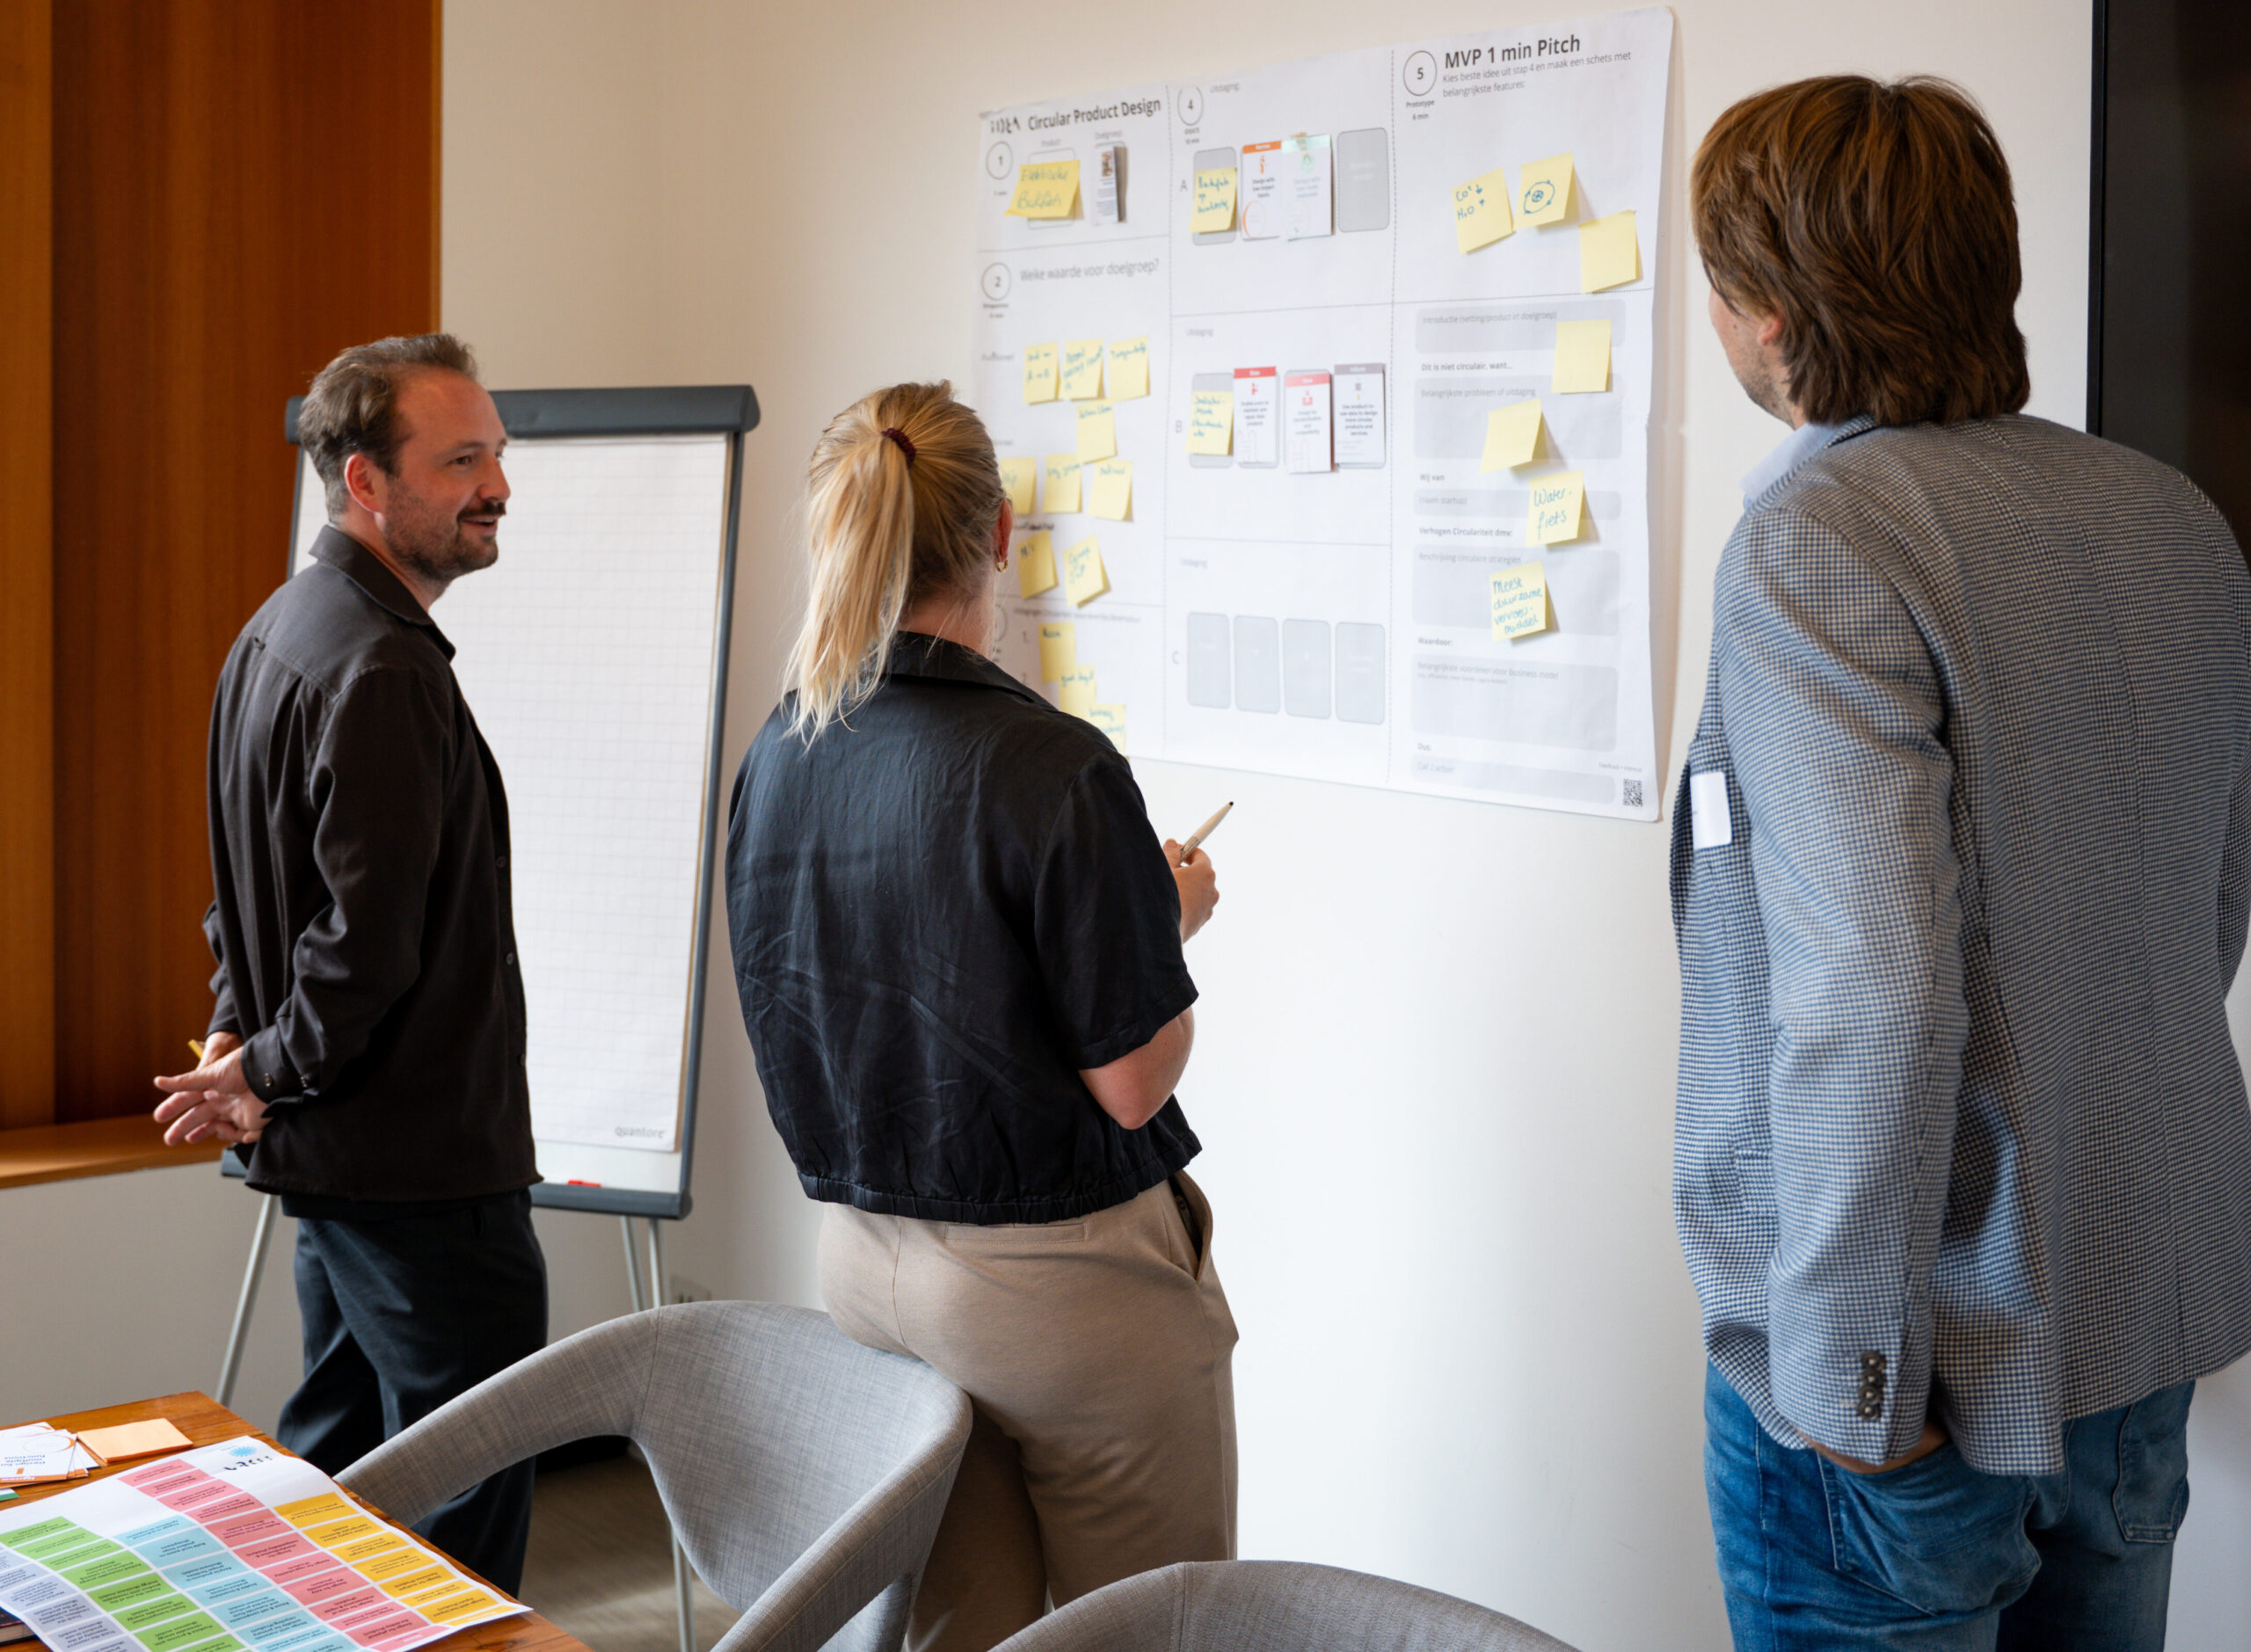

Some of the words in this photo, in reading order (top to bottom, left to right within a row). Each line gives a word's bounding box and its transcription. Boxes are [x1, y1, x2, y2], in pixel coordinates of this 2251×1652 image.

[1445, 48, 1482, 69] MVP
[1487, 47, 1496, 64] 1
[1501, 42, 1532, 62] min
[1538, 34, 1581, 57] Pitch
[1417, 67, 1424, 80] 5
[1443, 73, 1459, 84] Kies
[1460, 70, 1482, 81] beste
[1483, 69, 1500, 79] idee
[1501, 66, 1512, 76] uit
[1512, 64, 1528, 76] stap
[1535, 63, 1546, 72] en
[1548, 59, 1569, 70] maak
[1570, 58, 1585, 68] een
[1585, 53, 1613, 65] schets
[1614, 51, 1632, 62] met
[1442, 84, 1492, 98] belangrijkste
[1187, 98, 1195, 111] 4
[1028, 110, 1071, 131] Circular
[1074, 105, 1118, 125] Product
[1121, 98, 1162, 118] Design
[1180, 178, 1188, 192] A
[994, 275, 1002, 288] 2
[1421, 363, 1431, 373] Dit
[1433, 363, 1439, 372] is
[1440, 362, 1455, 372] niet
[1176, 420, 1182, 433] B
[1419, 472, 1431, 483] Wij
[1431, 474, 1446, 483] van
[1419, 526, 1451, 537] Verhogen
[1453, 527, 1494, 537] Circulariteit
